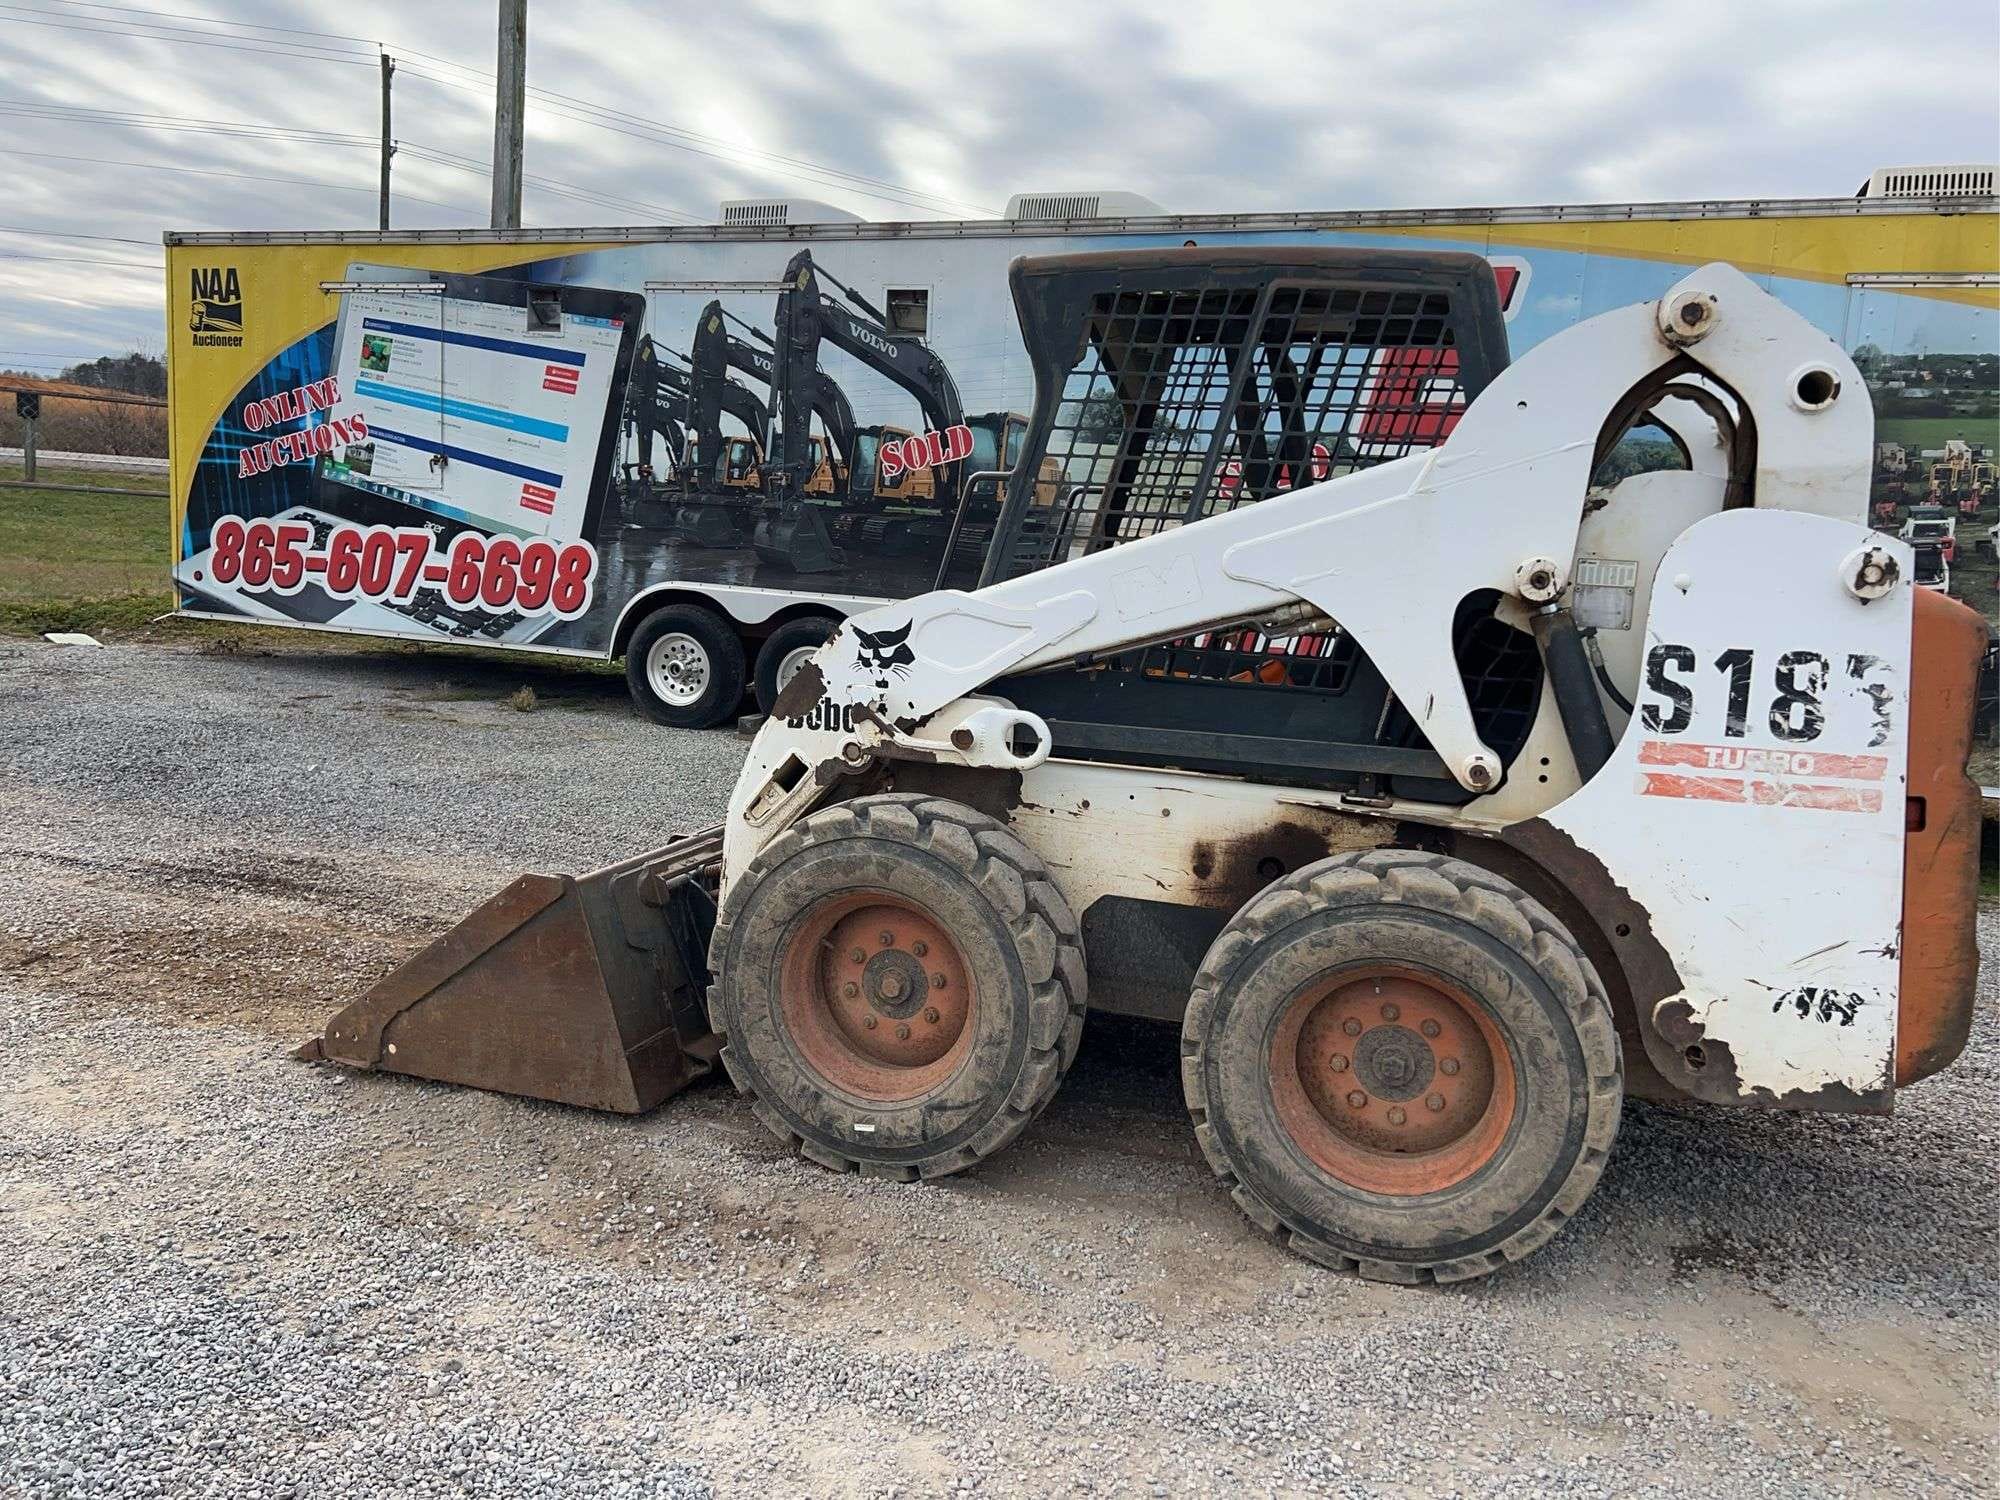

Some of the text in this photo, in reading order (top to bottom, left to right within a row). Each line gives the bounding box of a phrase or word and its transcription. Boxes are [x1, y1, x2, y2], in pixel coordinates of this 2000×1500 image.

[191, 268, 241, 303] NAA
[192, 333, 244, 347] Auctioneer
[849, 321, 898, 358] VOLVO
[243, 375, 342, 432] ONLINE
[238, 412, 368, 478] AUCTIONS
[880, 424, 975, 477] SOLD
[423, 520, 446, 534] acer
[211, 521, 592, 613] 865-607-6698
